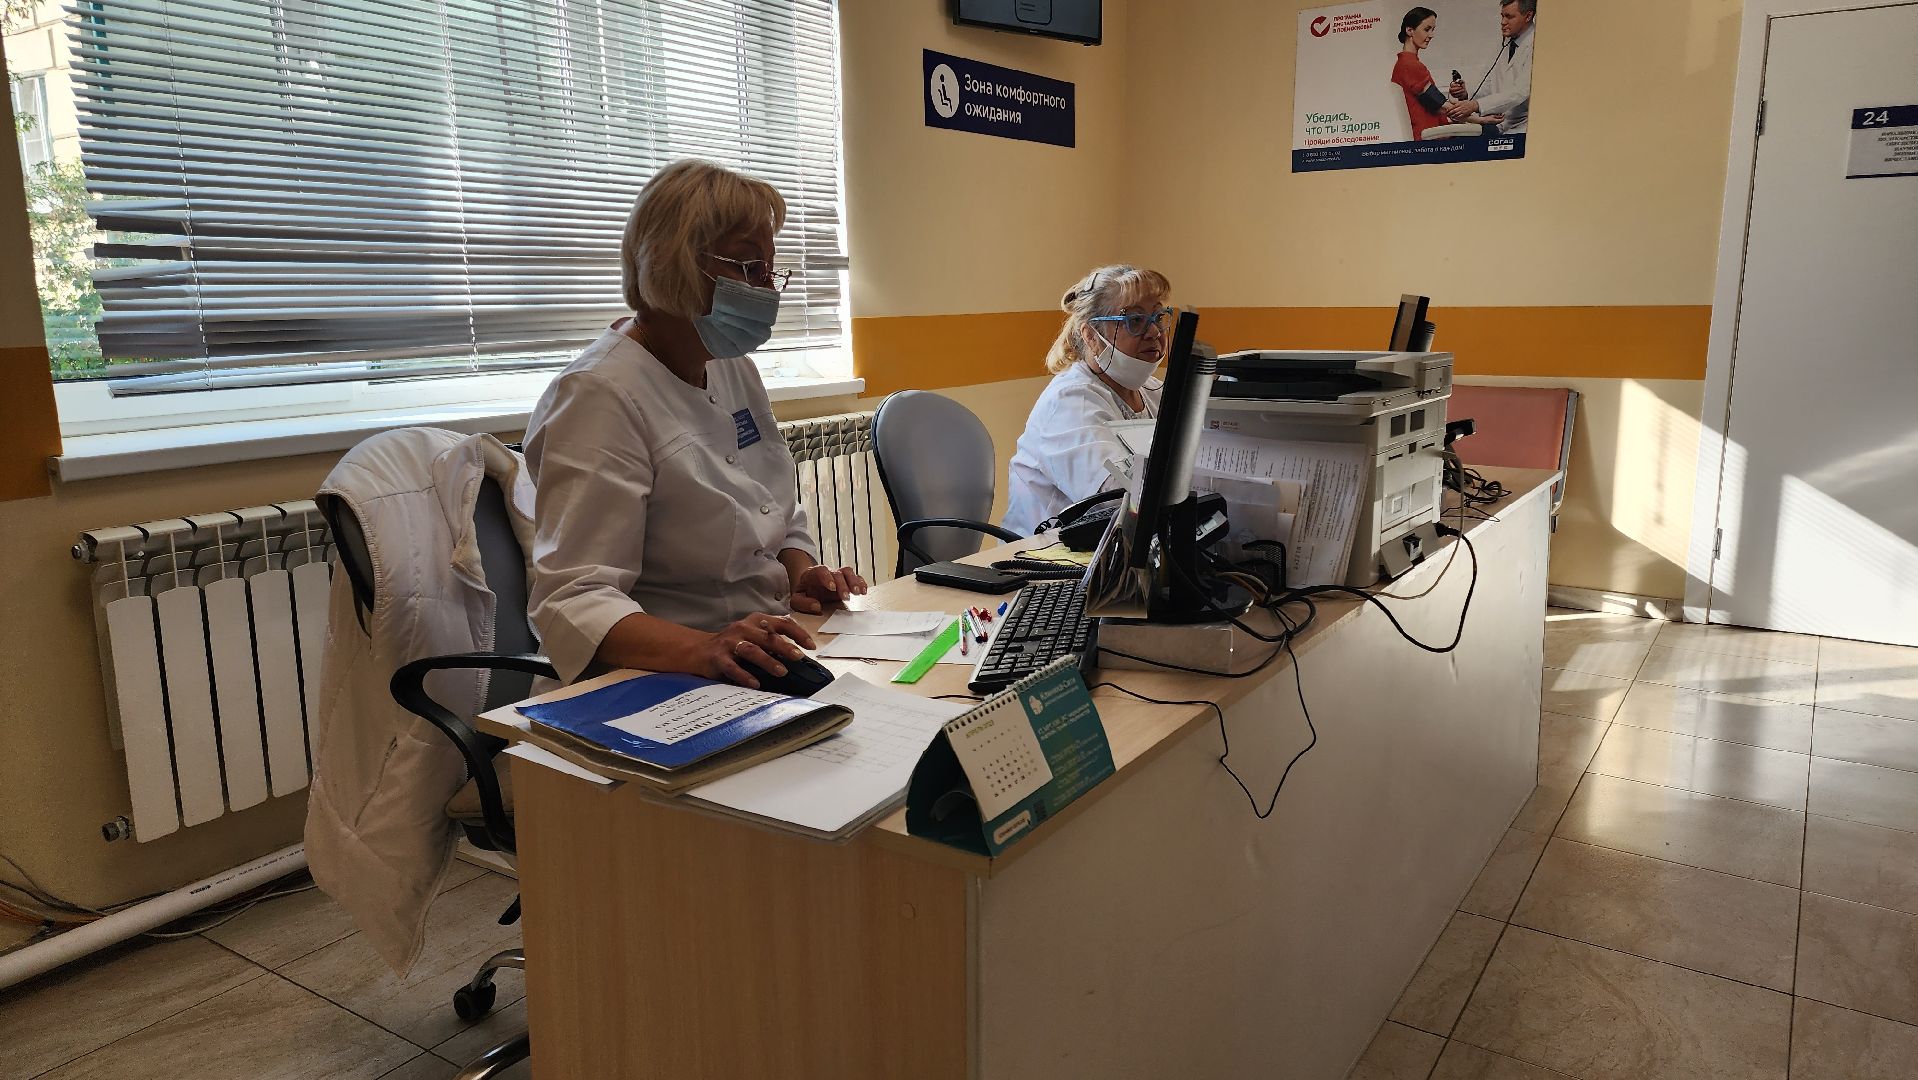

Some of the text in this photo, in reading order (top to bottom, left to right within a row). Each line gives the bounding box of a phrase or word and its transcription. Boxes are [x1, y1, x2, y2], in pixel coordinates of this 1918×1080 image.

[965, 73, 1066, 110] Зона комфортного
[964, 102, 1022, 124] ожидания
[1306, 112, 1353, 124] Убедись,
[1862, 110, 1890, 126] 24
[1305, 121, 1380, 136] что ты здоров
[1304, 139, 1331, 147] Пройди
[1488, 138, 1514, 146] СОГАЗ
